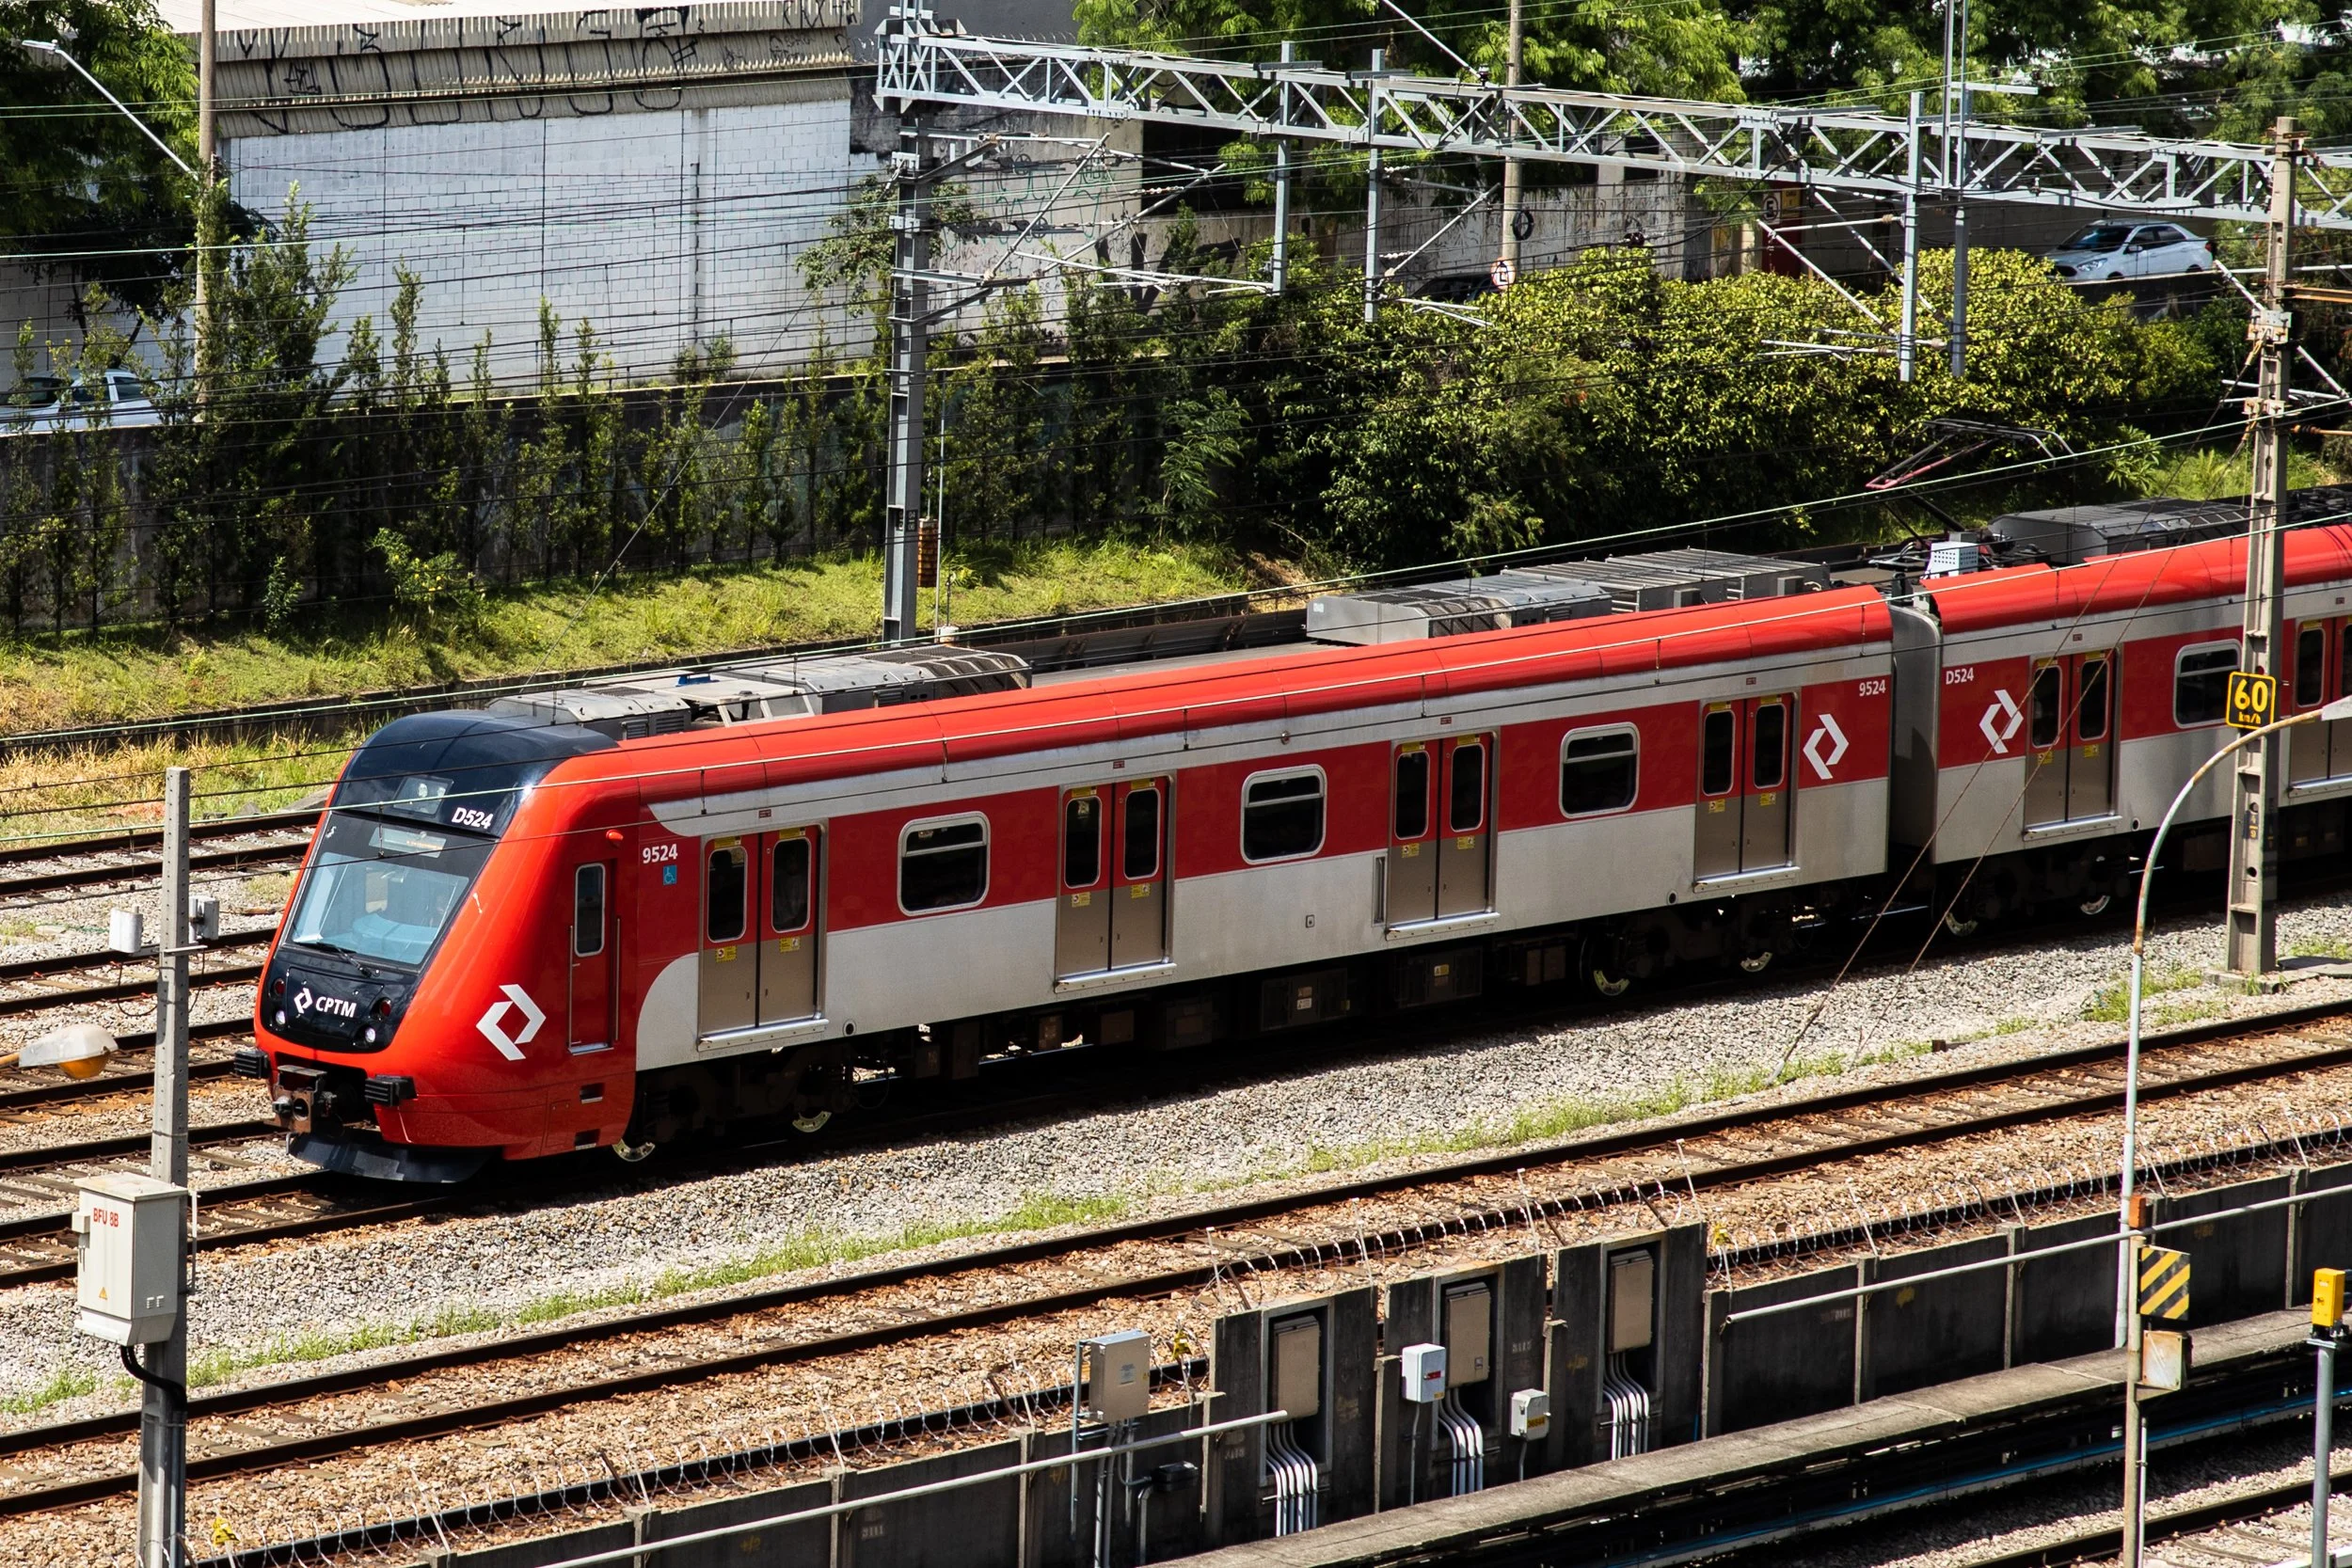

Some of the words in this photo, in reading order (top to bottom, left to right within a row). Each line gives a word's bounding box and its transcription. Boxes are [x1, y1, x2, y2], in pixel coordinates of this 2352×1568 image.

[1946, 667, 1974, 685] D524
[1859, 679, 1886, 697] 9524
[2234, 678, 2268, 712] 60
[2238, 711, 2261, 724] km/h
[452, 807, 494, 830] D524
[643, 843, 678, 864] 9524
[315, 996, 357, 1018] CPTM
[93, 1207, 108, 1225] BFU
